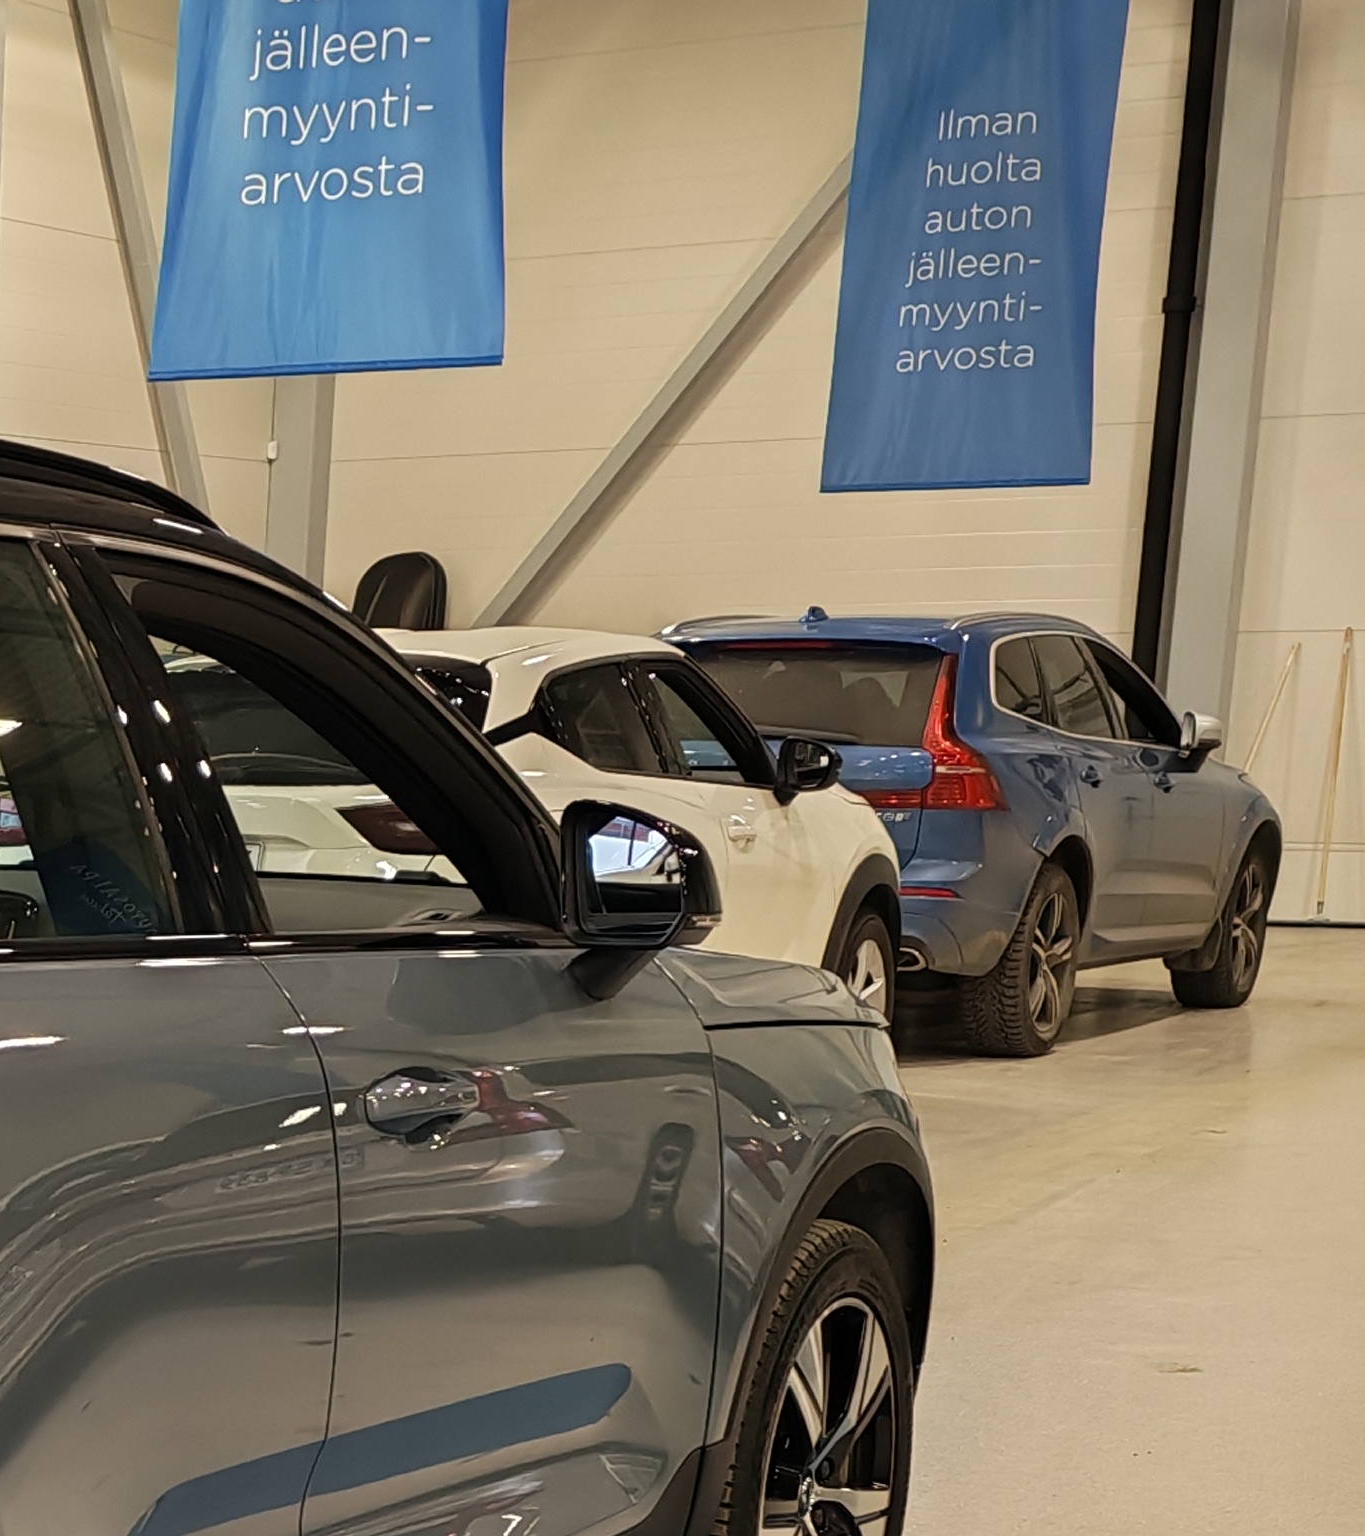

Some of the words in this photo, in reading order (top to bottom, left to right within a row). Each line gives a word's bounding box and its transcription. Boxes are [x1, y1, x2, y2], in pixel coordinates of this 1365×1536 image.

[249, 23, 432, 81] jälleen-
[242, 83, 435, 146] myynti-
[936, 108, 1039, 142] Ilman
[240, 154, 425, 206] arvosta
[925, 151, 1043, 188] huolta
[923, 201, 1032, 235] auton
[905, 248, 1042, 288] jälleen-
[898, 291, 1043, 331] myynti-
[895, 340, 1036, 375] arvosta
